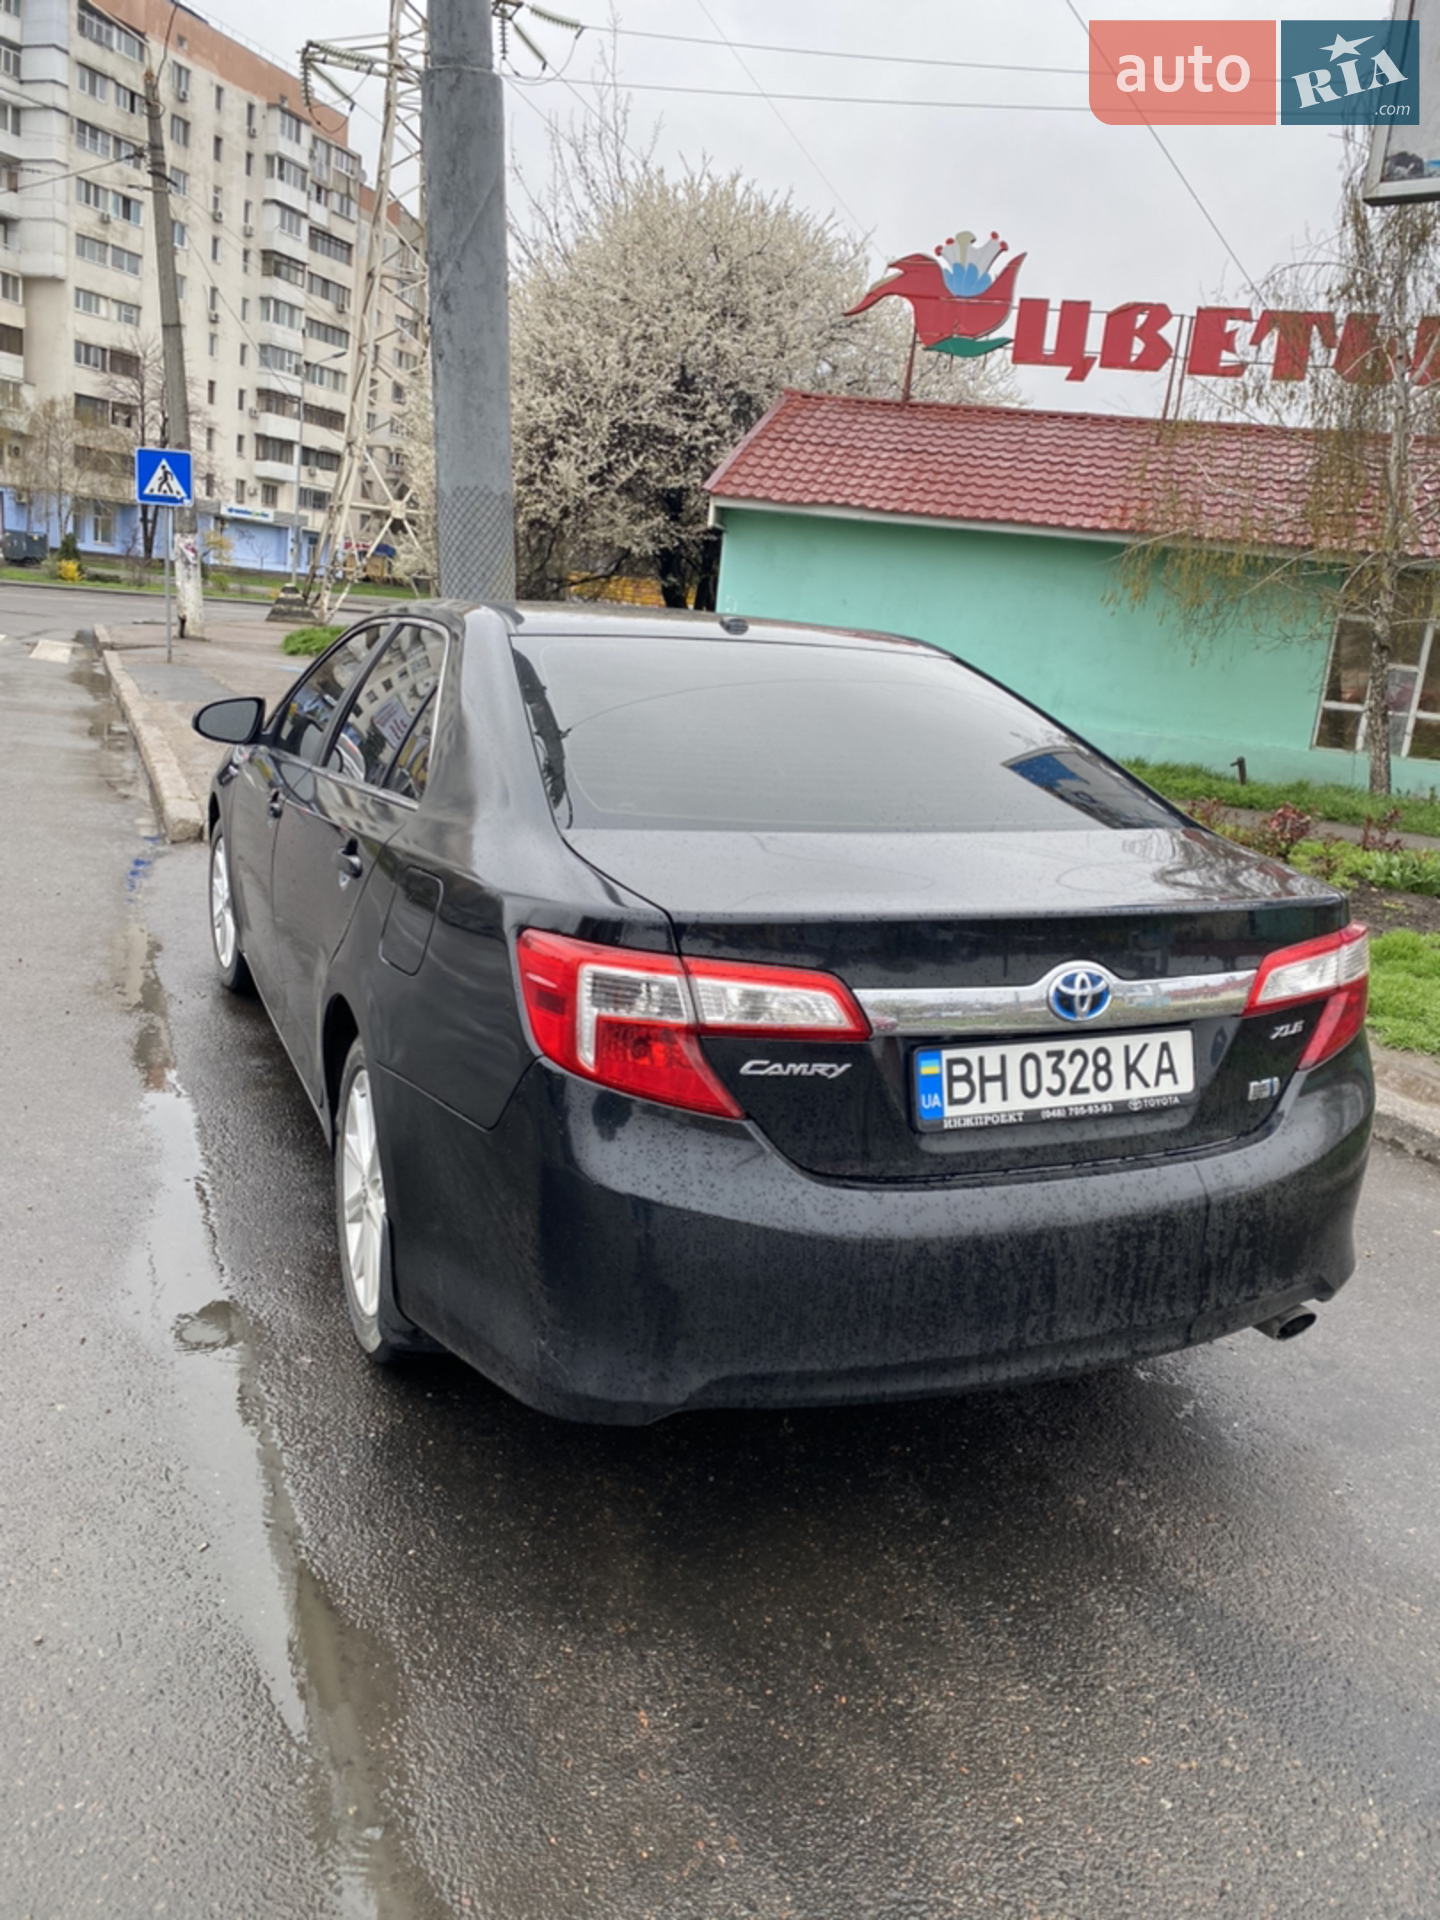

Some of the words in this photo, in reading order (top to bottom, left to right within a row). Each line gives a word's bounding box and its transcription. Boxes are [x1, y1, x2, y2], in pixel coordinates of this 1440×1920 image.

[1269, 1020, 1305, 1040] XLE
[740, 1060, 852, 1078] CAMRY
[946, 1053, 1007, 1107] BH
[1020, 1046, 1113, 1100] 0328
[1124, 1041, 1179, 1090] KA
[922, 1093, 942, 1109] UA
[1143, 1096, 1181, 1108] TOYOTA
